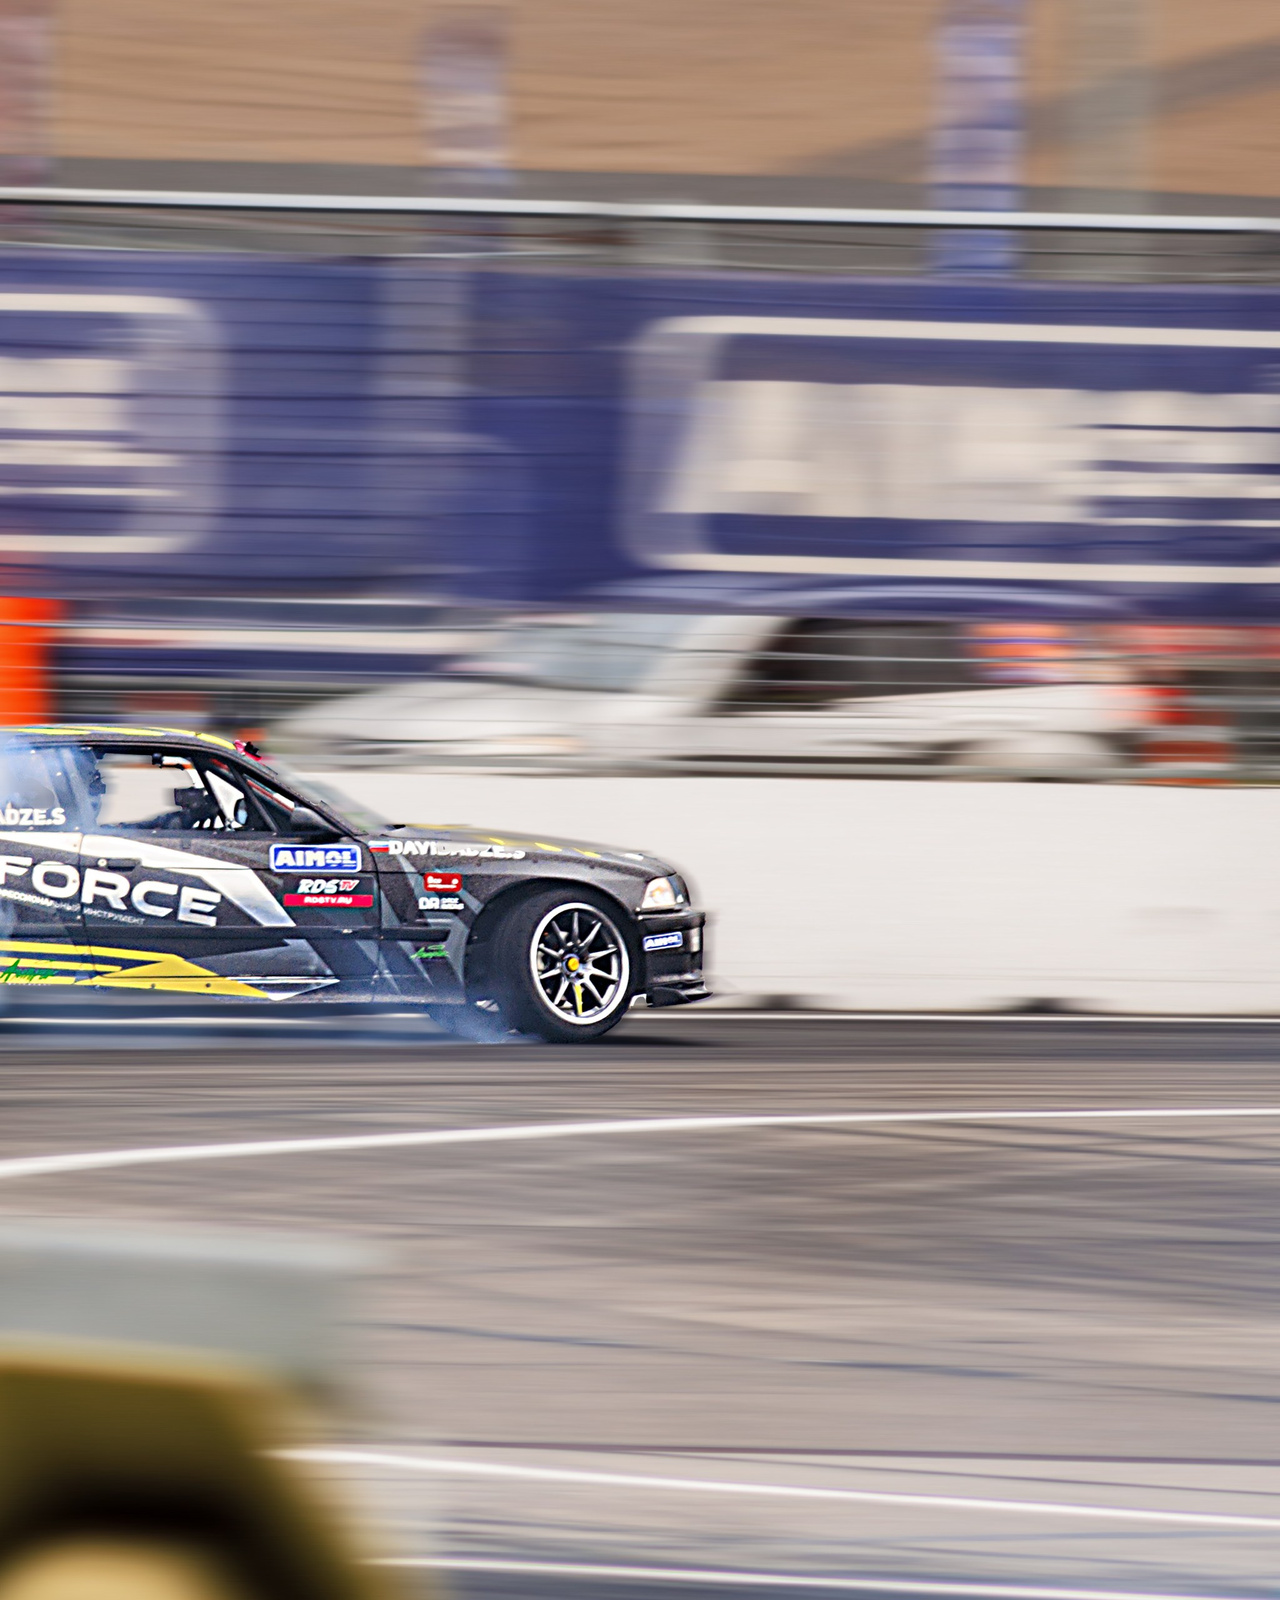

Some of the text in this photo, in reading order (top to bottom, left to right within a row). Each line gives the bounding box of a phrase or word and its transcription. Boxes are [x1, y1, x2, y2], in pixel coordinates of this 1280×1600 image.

[275, 850, 358, 868] AIMOL
[297, 879, 360, 894] RDS TV
